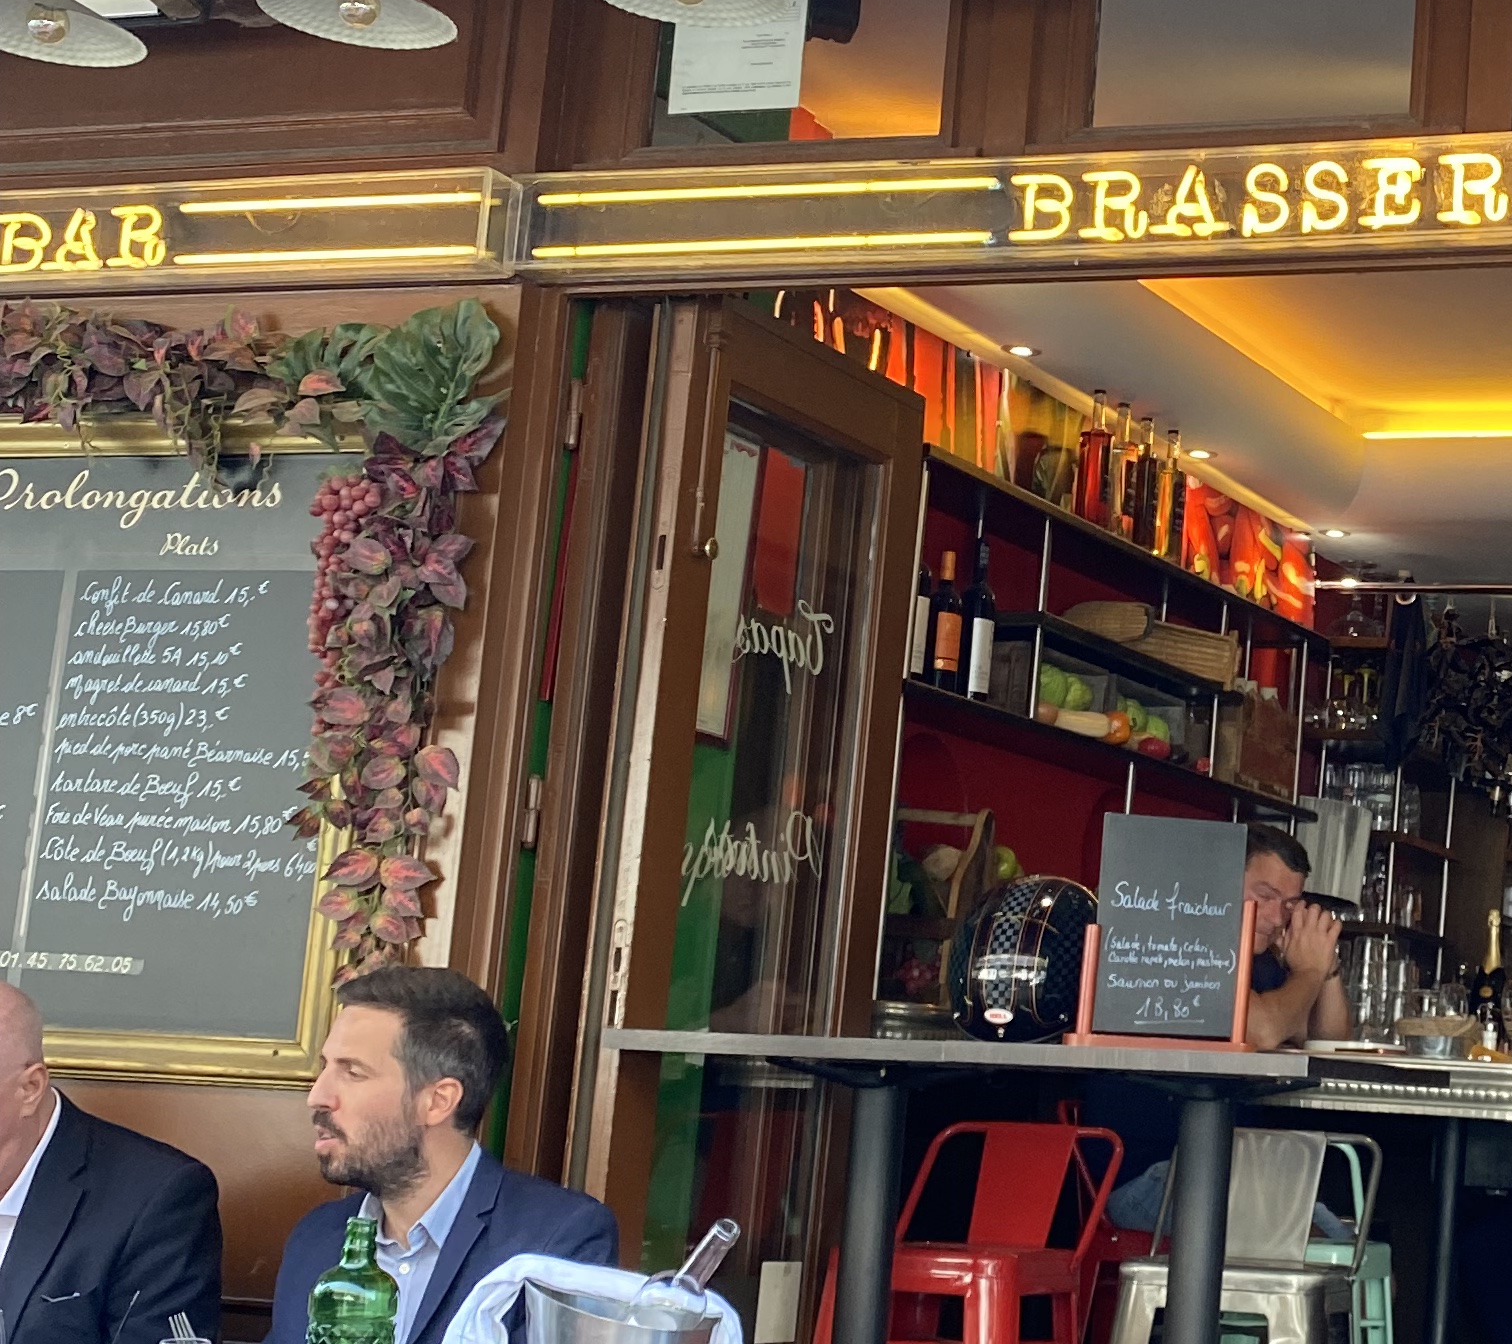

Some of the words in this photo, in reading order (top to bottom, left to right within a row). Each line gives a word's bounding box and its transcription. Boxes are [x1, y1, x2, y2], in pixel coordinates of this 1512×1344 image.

[0, 204, 167, 272] BAR
[159, 532, 219, 556] Plats
[132, 579, 155, 603] de
[121, 673, 143, 693] de
[55, 733, 94, 763] pied
[91, 735, 111, 756] de
[109, 742, 146, 764] porc
[143, 739, 193, 764] pané
[50, 768, 118, 792] tartare
[117, 773, 140, 795] de
[73, 802, 89, 825] de
[80, 835, 104, 863] de
[1111, 881, 1159, 911] Salade
